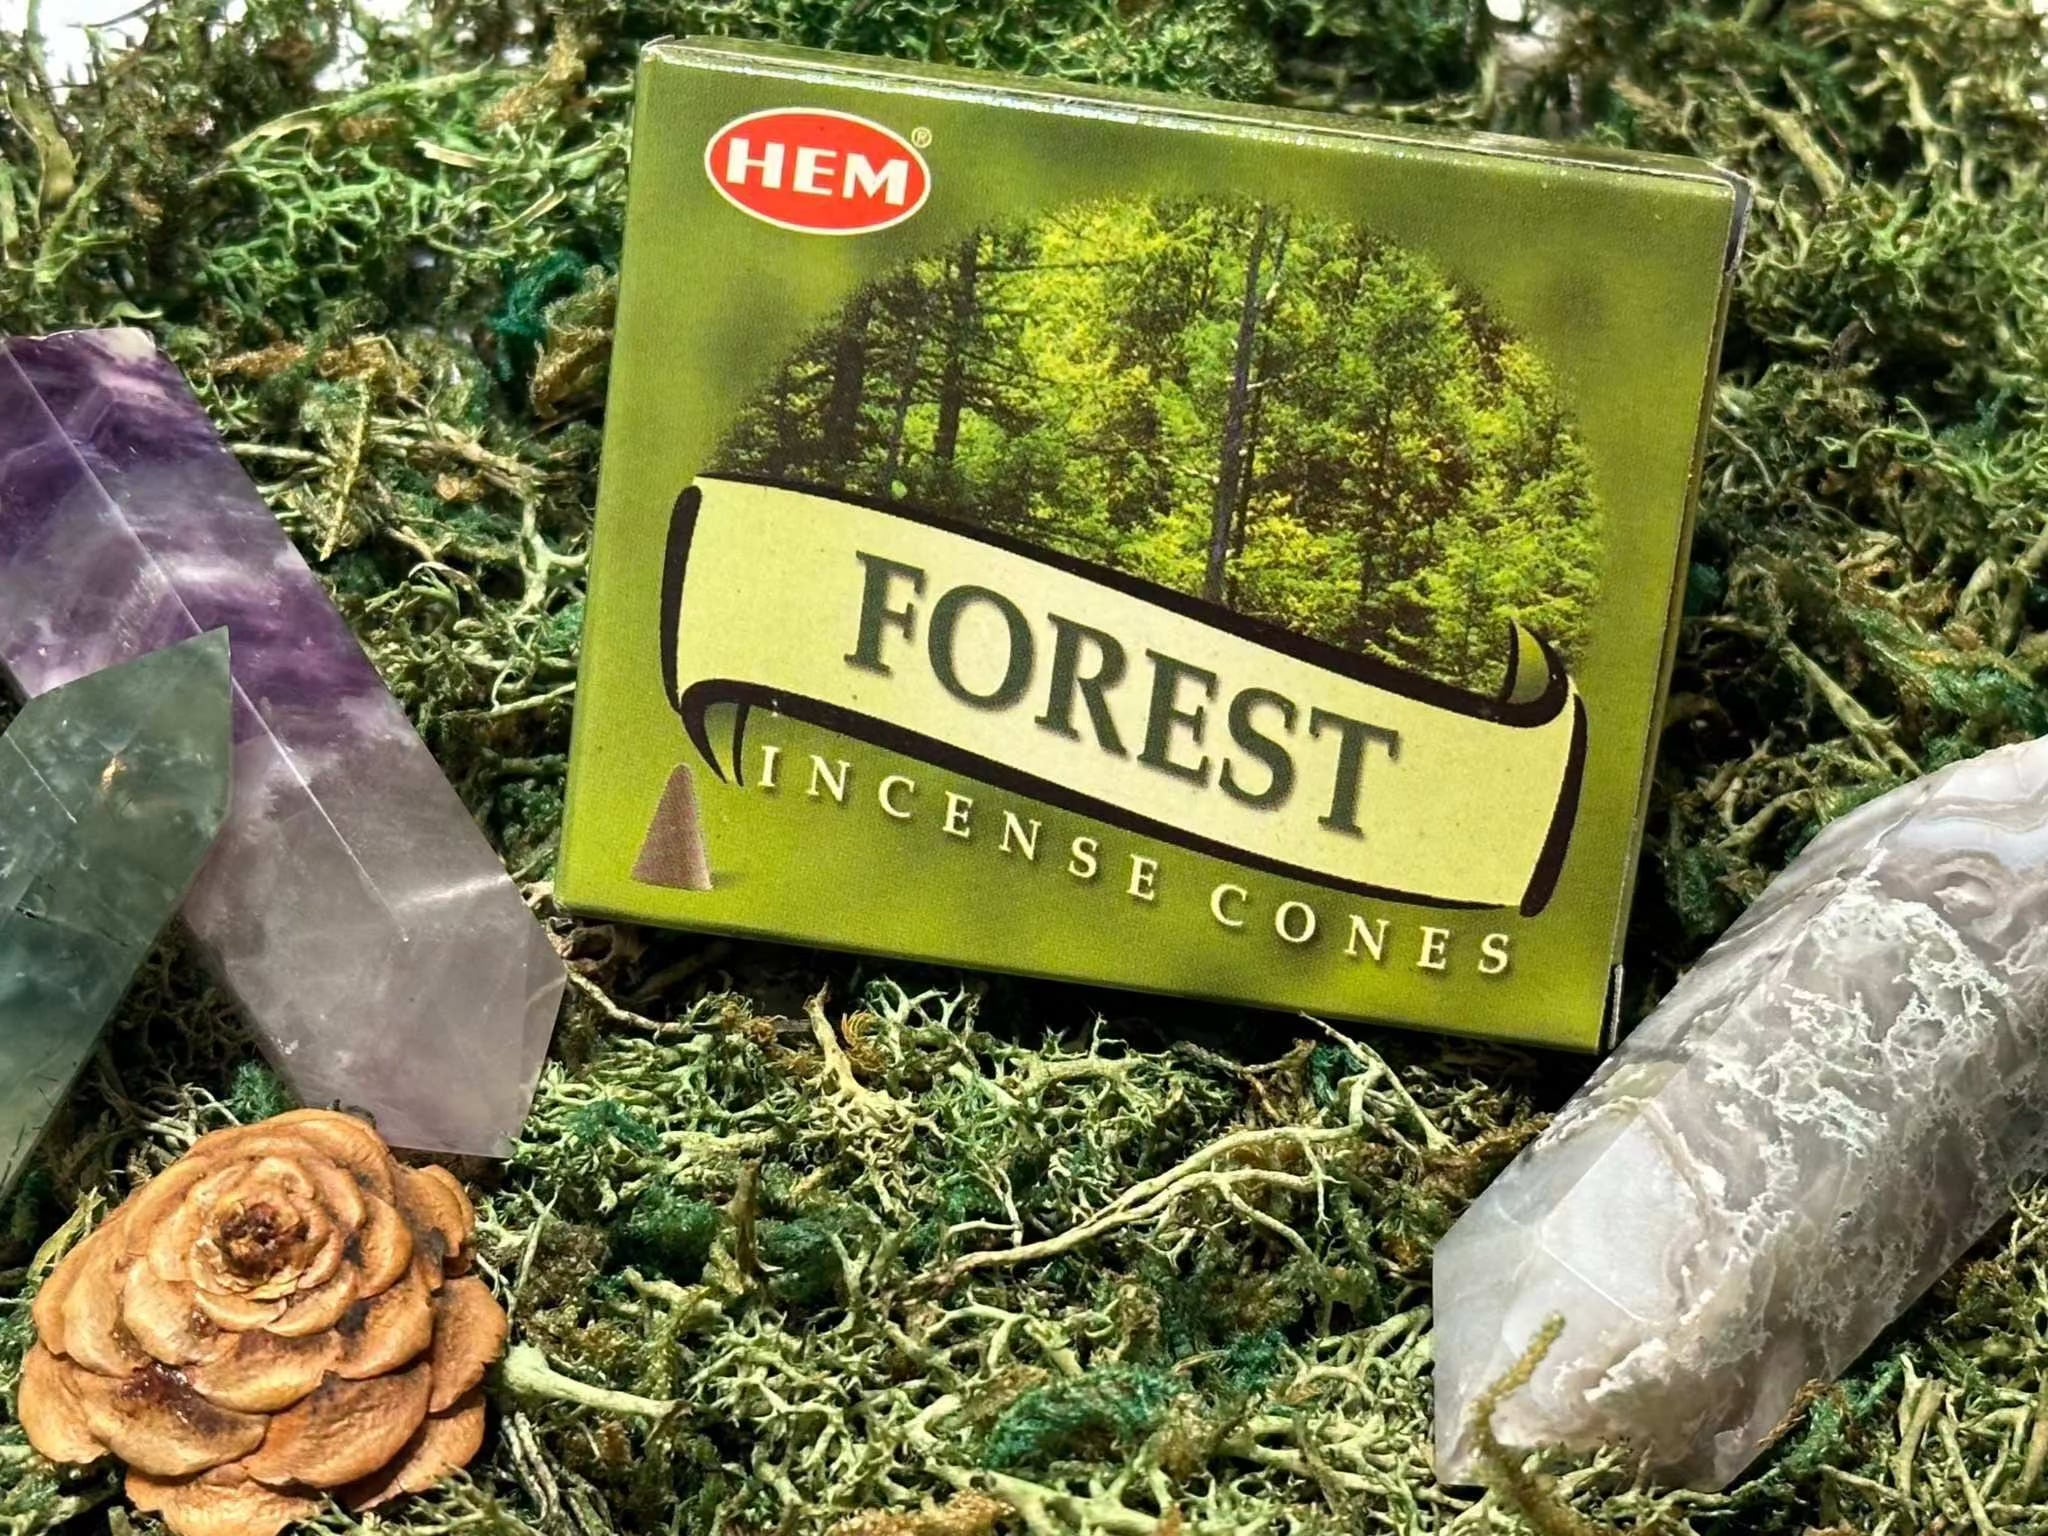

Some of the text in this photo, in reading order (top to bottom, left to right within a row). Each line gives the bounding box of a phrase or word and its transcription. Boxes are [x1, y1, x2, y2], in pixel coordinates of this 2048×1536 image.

[726, 137, 909, 205] HEM
[844, 550, 1401, 837] FOREST
[758, 745, 1510, 974] INCENSE CONES
